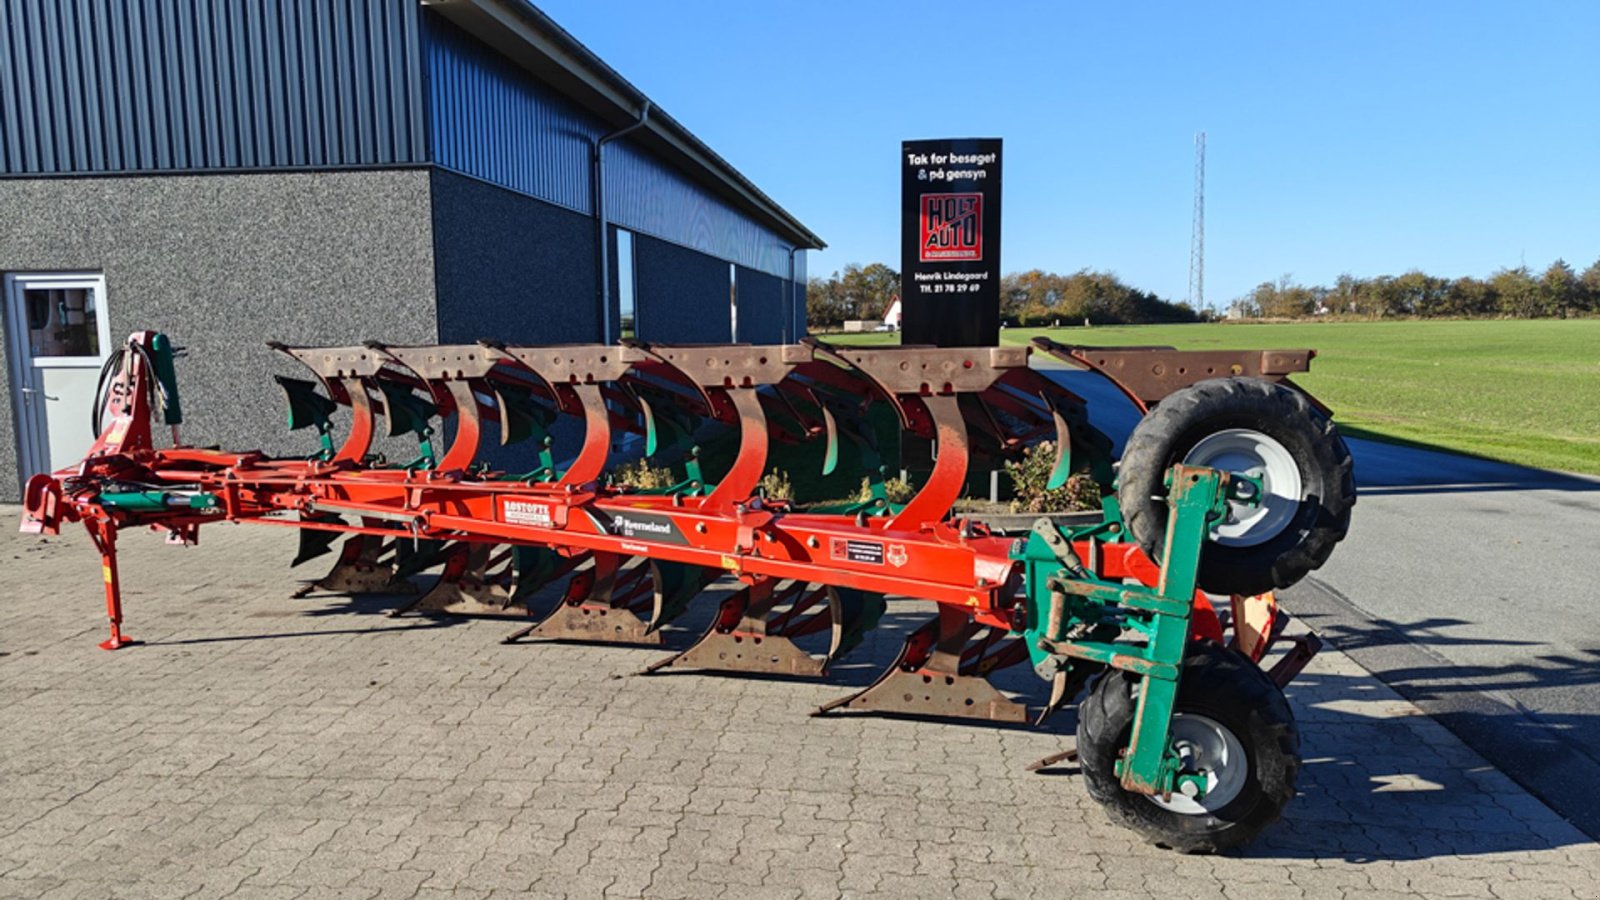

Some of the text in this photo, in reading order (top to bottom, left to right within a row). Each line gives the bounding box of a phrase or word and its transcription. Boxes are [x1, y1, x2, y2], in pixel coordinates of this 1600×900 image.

[908, 154, 928, 165] Tak
[930, 153, 947, 165] for
[918, 168, 987, 182] & på gensyn
[928, 198, 977, 232] HOLT
[926, 213, 977, 248] AUTO
[914, 271, 988, 281] Henrik Lindegaard
